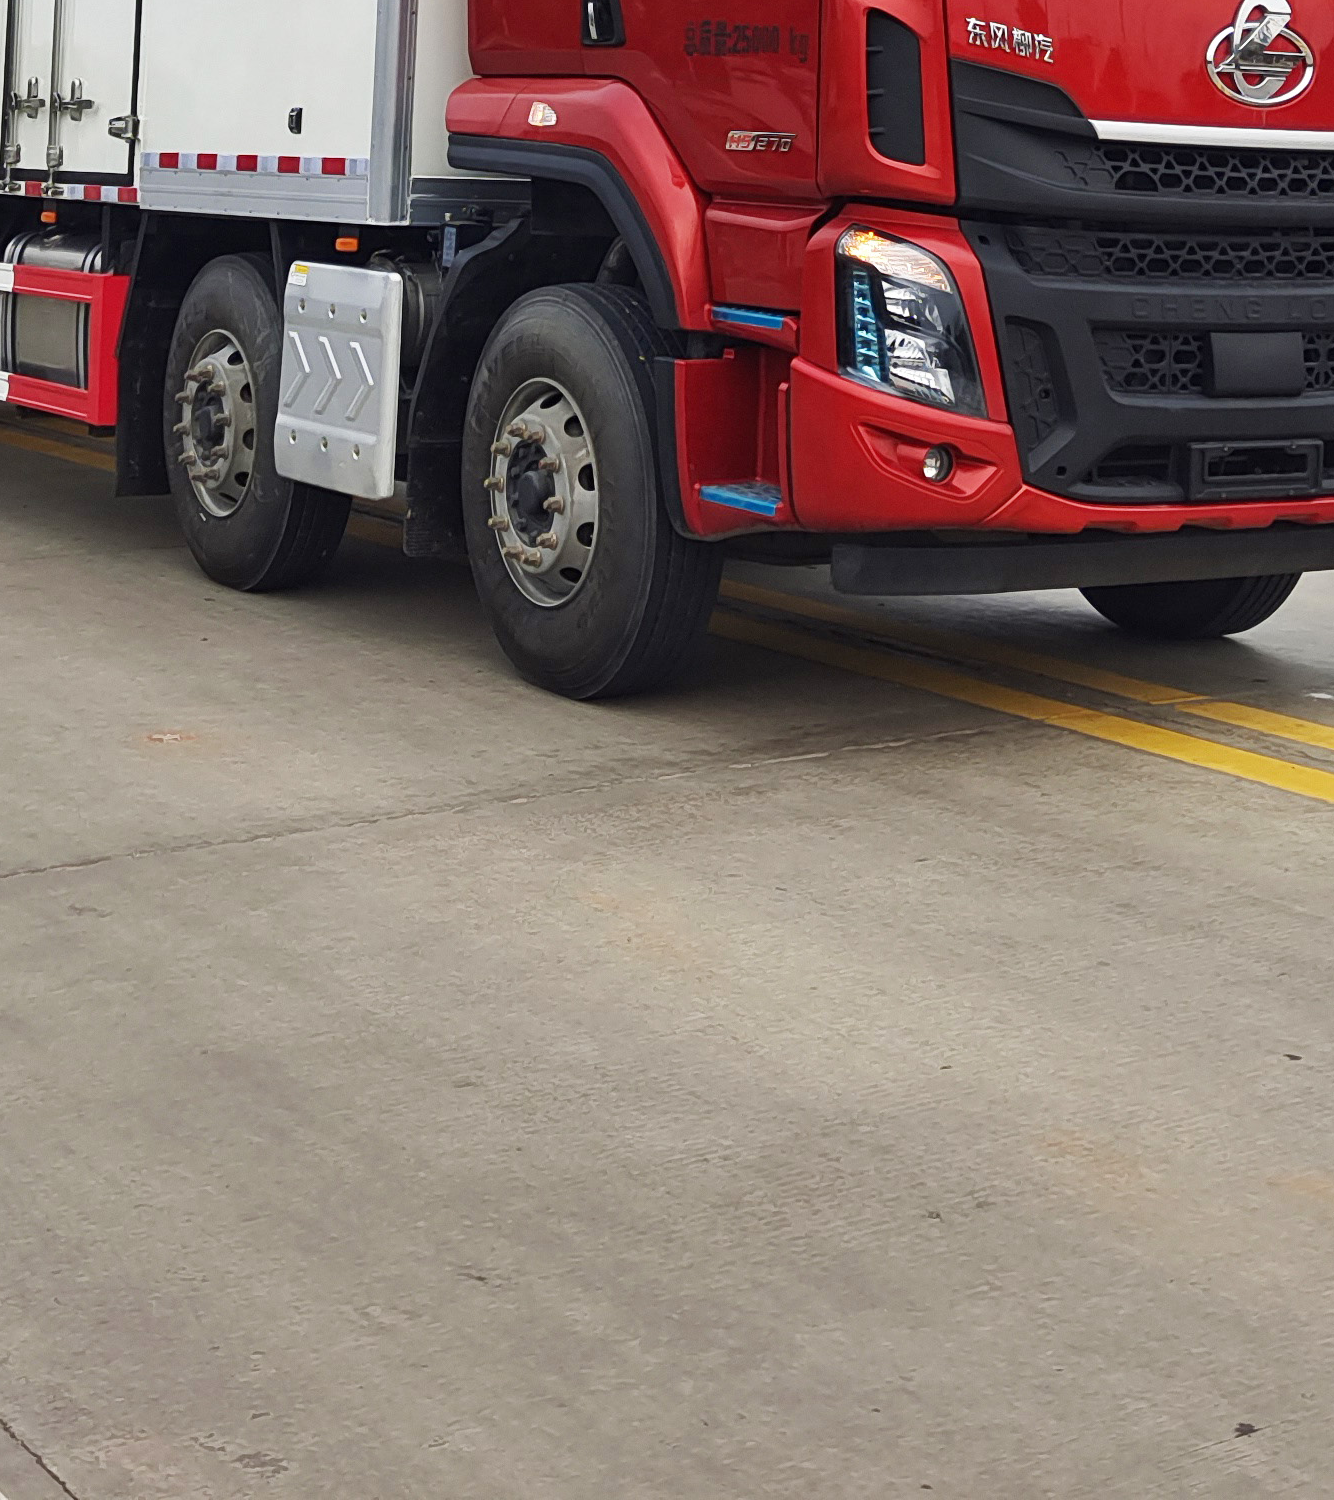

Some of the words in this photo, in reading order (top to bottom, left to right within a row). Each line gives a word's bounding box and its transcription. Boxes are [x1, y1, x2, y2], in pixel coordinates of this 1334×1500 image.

[965, 17, 1054, 64] 东风柳汽
[755, 137, 793, 152] 270
[1131, 297, 1263, 321] CHENG
